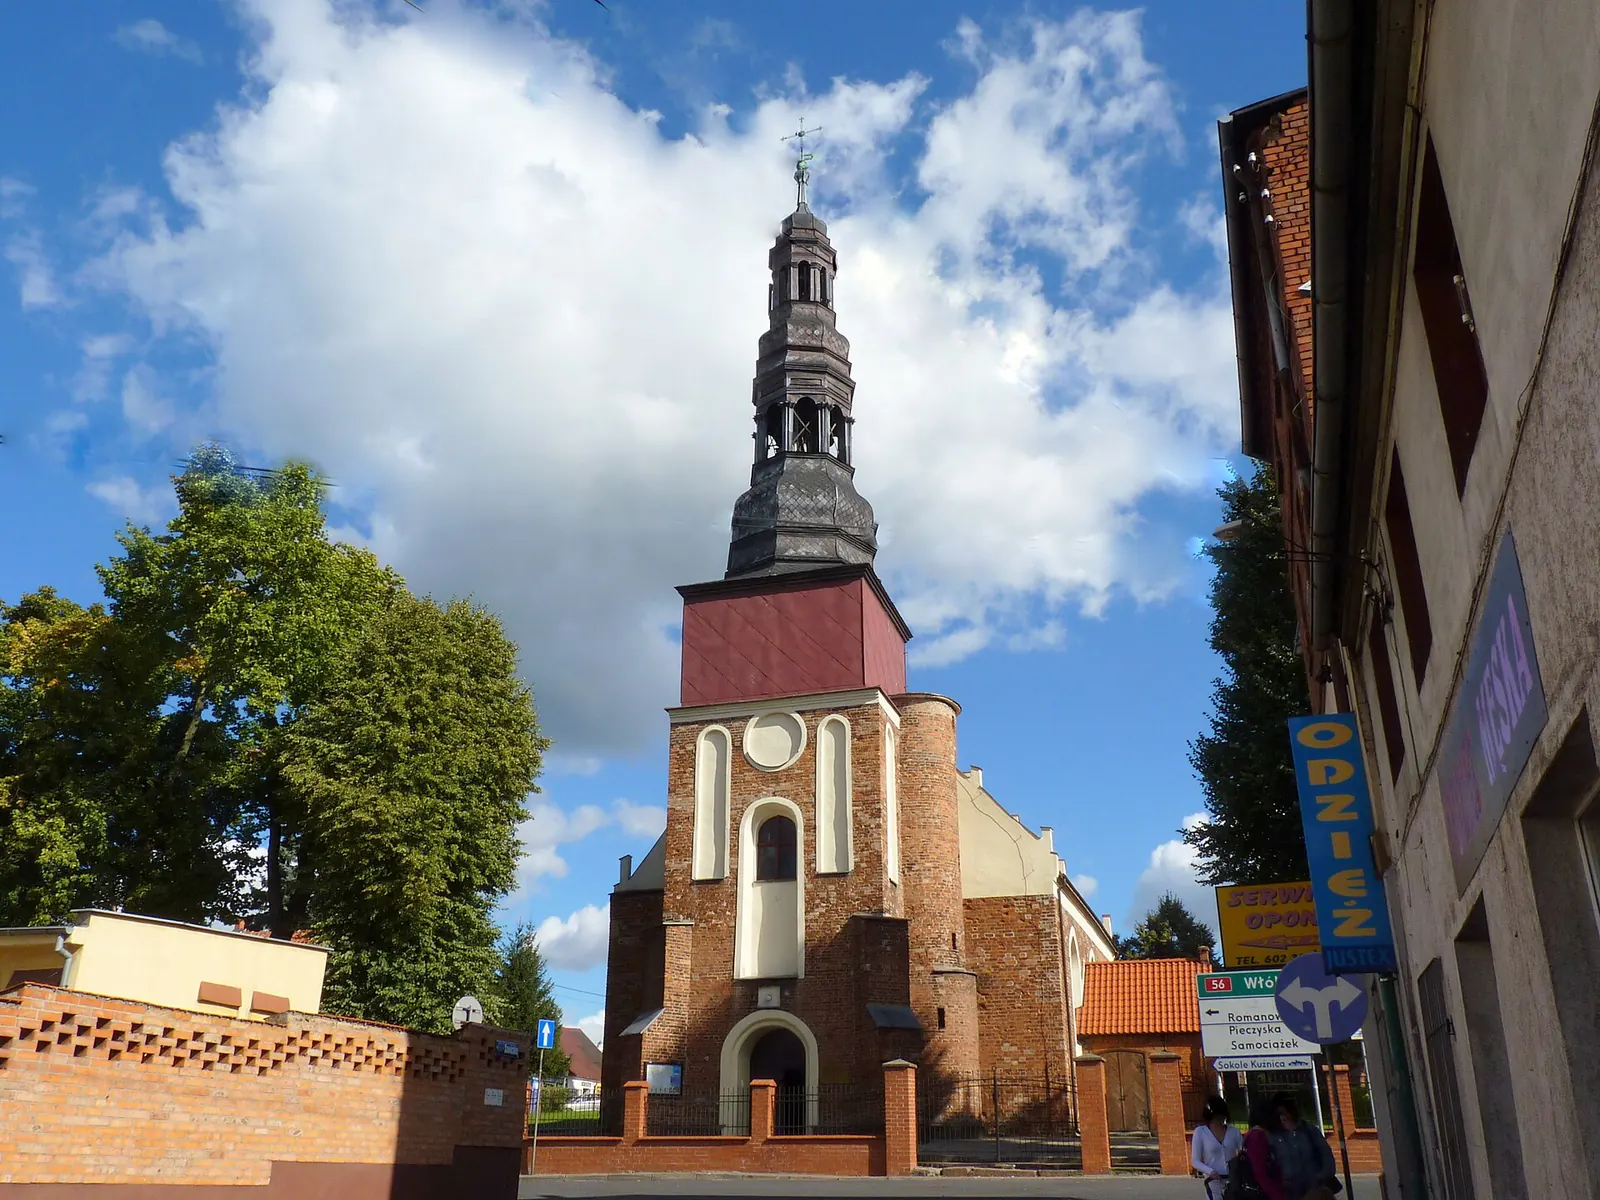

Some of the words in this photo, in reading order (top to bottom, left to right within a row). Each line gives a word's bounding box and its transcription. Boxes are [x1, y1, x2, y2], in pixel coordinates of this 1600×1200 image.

[1297, 722, 1377, 937] ODZIEŻ
[1226, 886, 1314, 908] SERWI
[1245, 909, 1319, 930] OPON
[1235, 955, 1260, 966] TEL.
[1264, 954, 1286, 964] 602
[1326, 948, 1393, 971] JUSTEX
[1211, 979, 1226, 990] 56
[1243, 975, 1278, 990] Włó
[1228, 1012, 1282, 1022] Romanow
[1229, 1024, 1282, 1036] Pieczyska
[1231, 1038, 1299, 1051] Samociążek
[1218, 1060, 1248, 1070] Sokole
